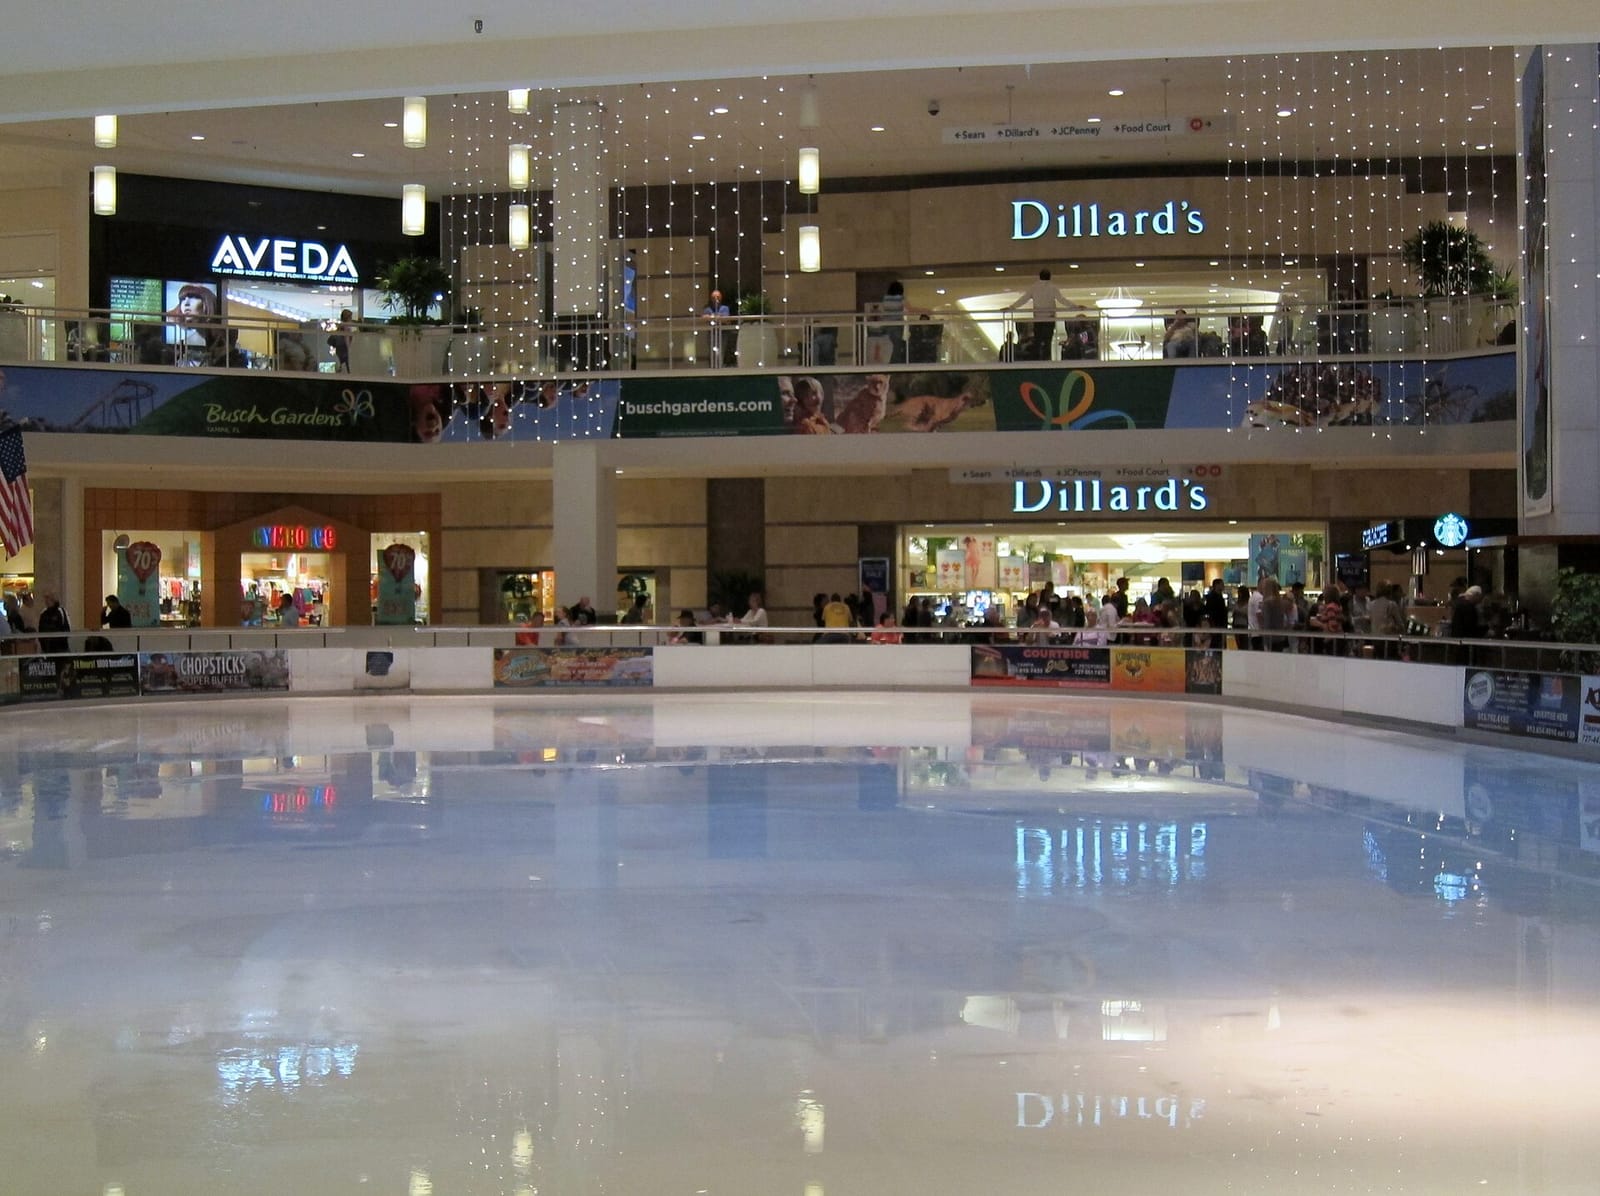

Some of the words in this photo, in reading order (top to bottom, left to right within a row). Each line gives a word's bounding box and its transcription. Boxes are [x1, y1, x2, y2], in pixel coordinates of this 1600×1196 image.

[962, 130, 986, 140] Sears
[1004, 128, 1040, 138] Dillard's
[1058, 126, 1101, 137] JCPenney
[1121, 124, 1144, 133] Food
[1146, 123, 1171, 133] Court
[1011, 200, 1205, 240] Dillard's
[211, 235, 359, 277] AVEDA
[203, 402, 269, 423] Busch
[271, 407, 342, 426] Gardens
[626, 399, 773, 416] buschgardens.com
[1122, 467, 1144, 477] Food
[1146, 467, 1170, 477] Court
[1012, 479, 1207, 513] Dillard's
[1023, 649, 1089, 659] COURTSIDE
[180, 655, 246, 676] CHOPSTICKS
[183, 676, 210, 687] SUPER
[211, 674, 245, 686] BUFFET
